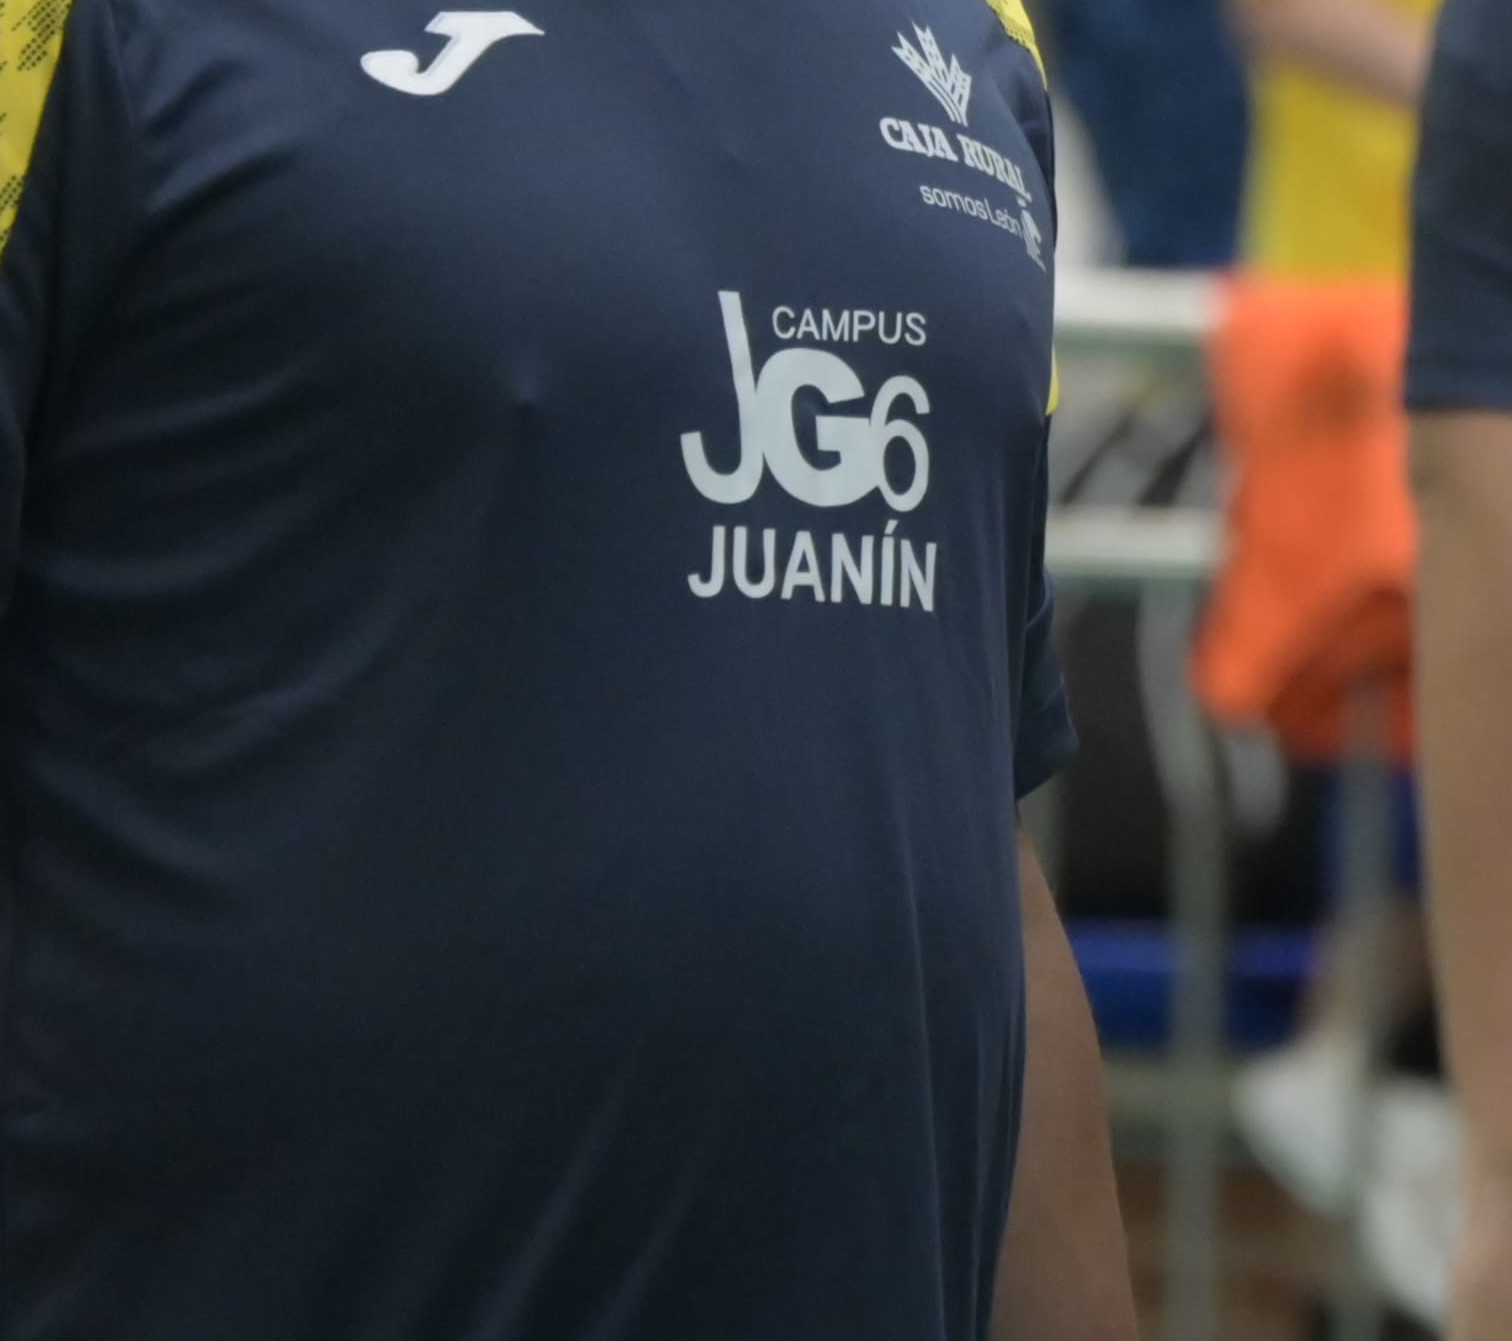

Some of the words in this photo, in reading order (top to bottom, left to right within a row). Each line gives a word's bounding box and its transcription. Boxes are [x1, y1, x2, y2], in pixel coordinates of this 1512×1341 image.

[879, 116, 959, 162] CAJA
[957, 133, 1032, 203] RURAL
[772, 304, 927, 347] CAMPUS
[681, 290, 930, 512] JG6
[688, 520, 937, 612] JUANÍN
